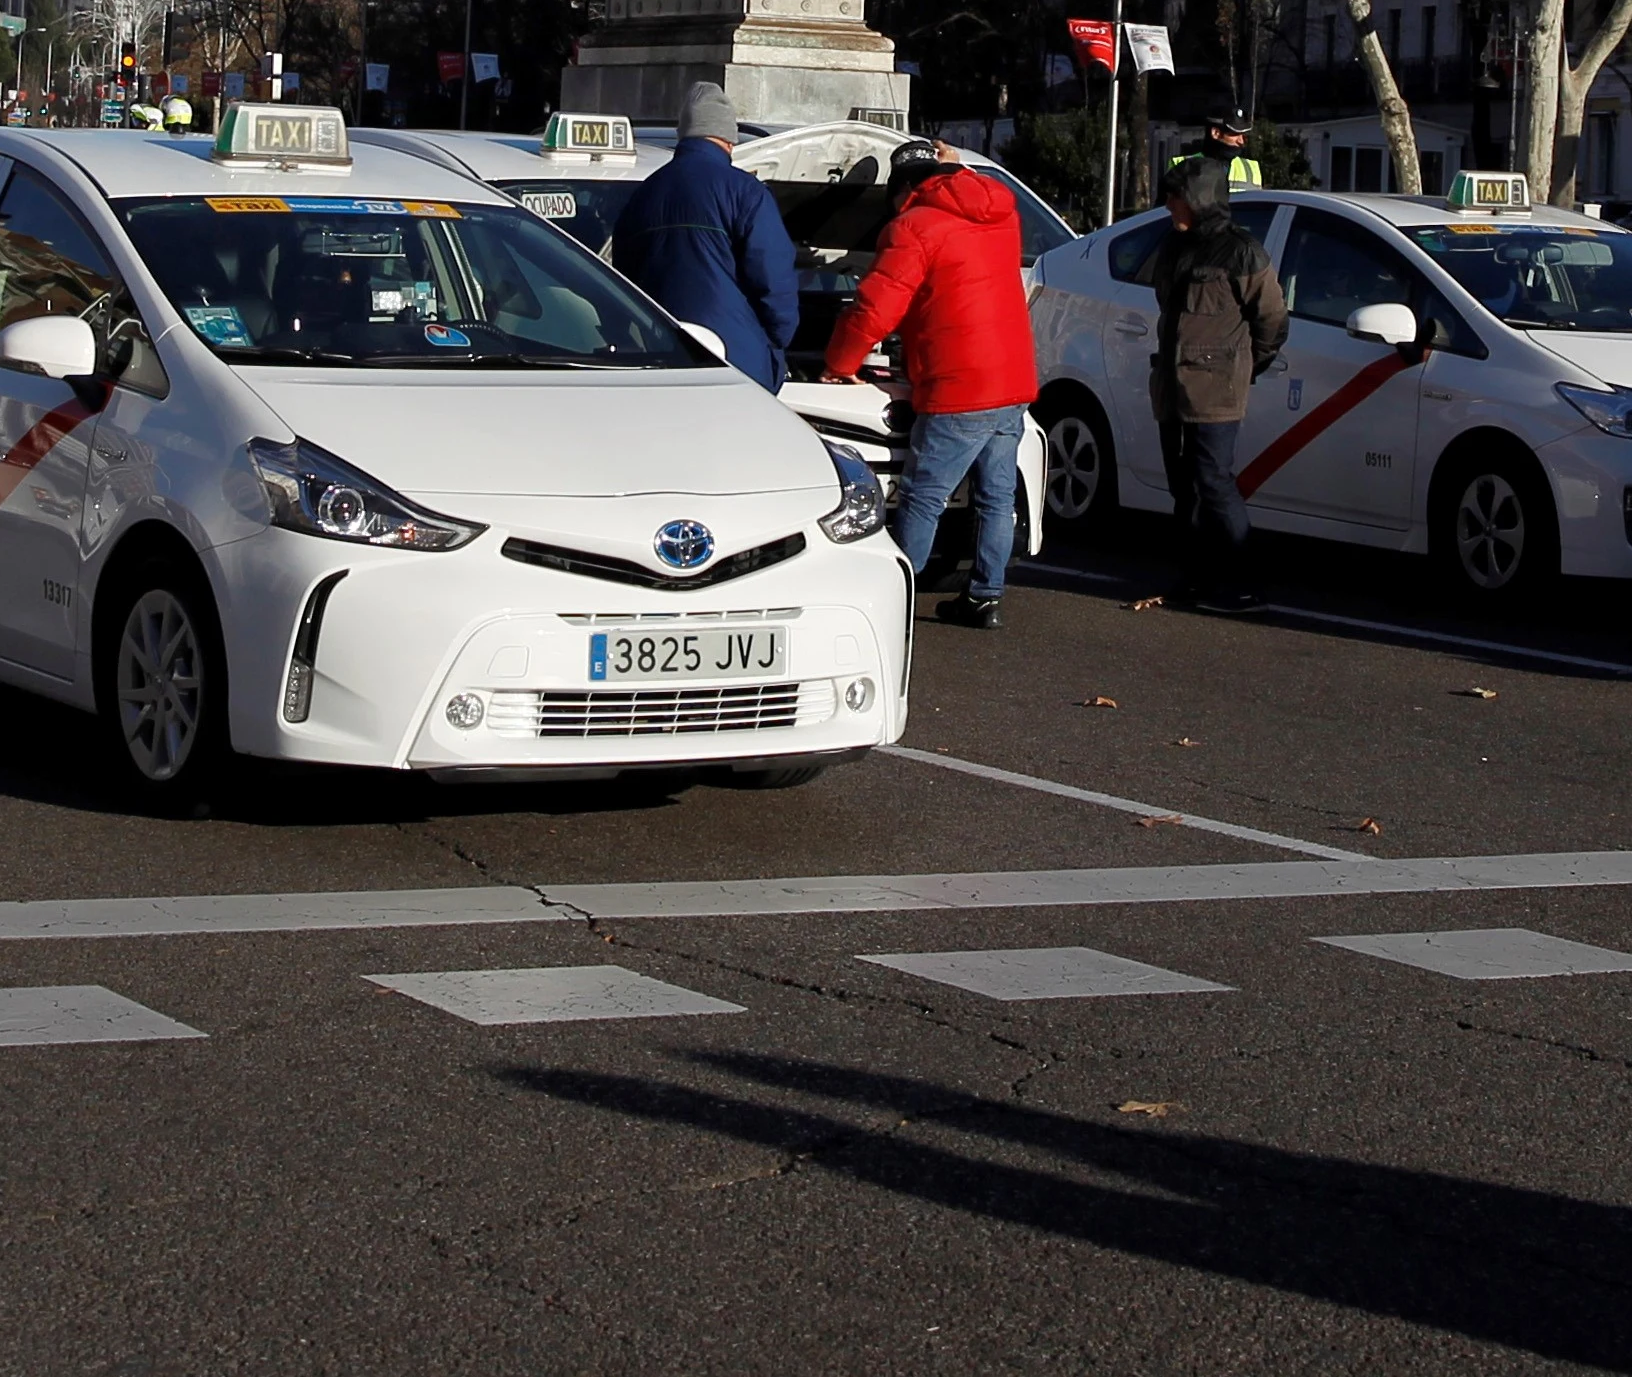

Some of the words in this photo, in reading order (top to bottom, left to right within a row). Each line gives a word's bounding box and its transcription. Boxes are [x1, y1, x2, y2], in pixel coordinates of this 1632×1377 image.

[258, 120, 308, 148] TAXI
[574, 124, 607, 144] TAXI
[1479, 182, 1507, 202] TAXI
[525, 195, 573, 215] OCUPADO
[1365, 452, 1391, 469] 05111
[43, 579, 72, 608] 13317
[614, 636, 701, 673] 3825
[715, 633, 775, 670] JVJ
[594, 662, 602, 672] E
